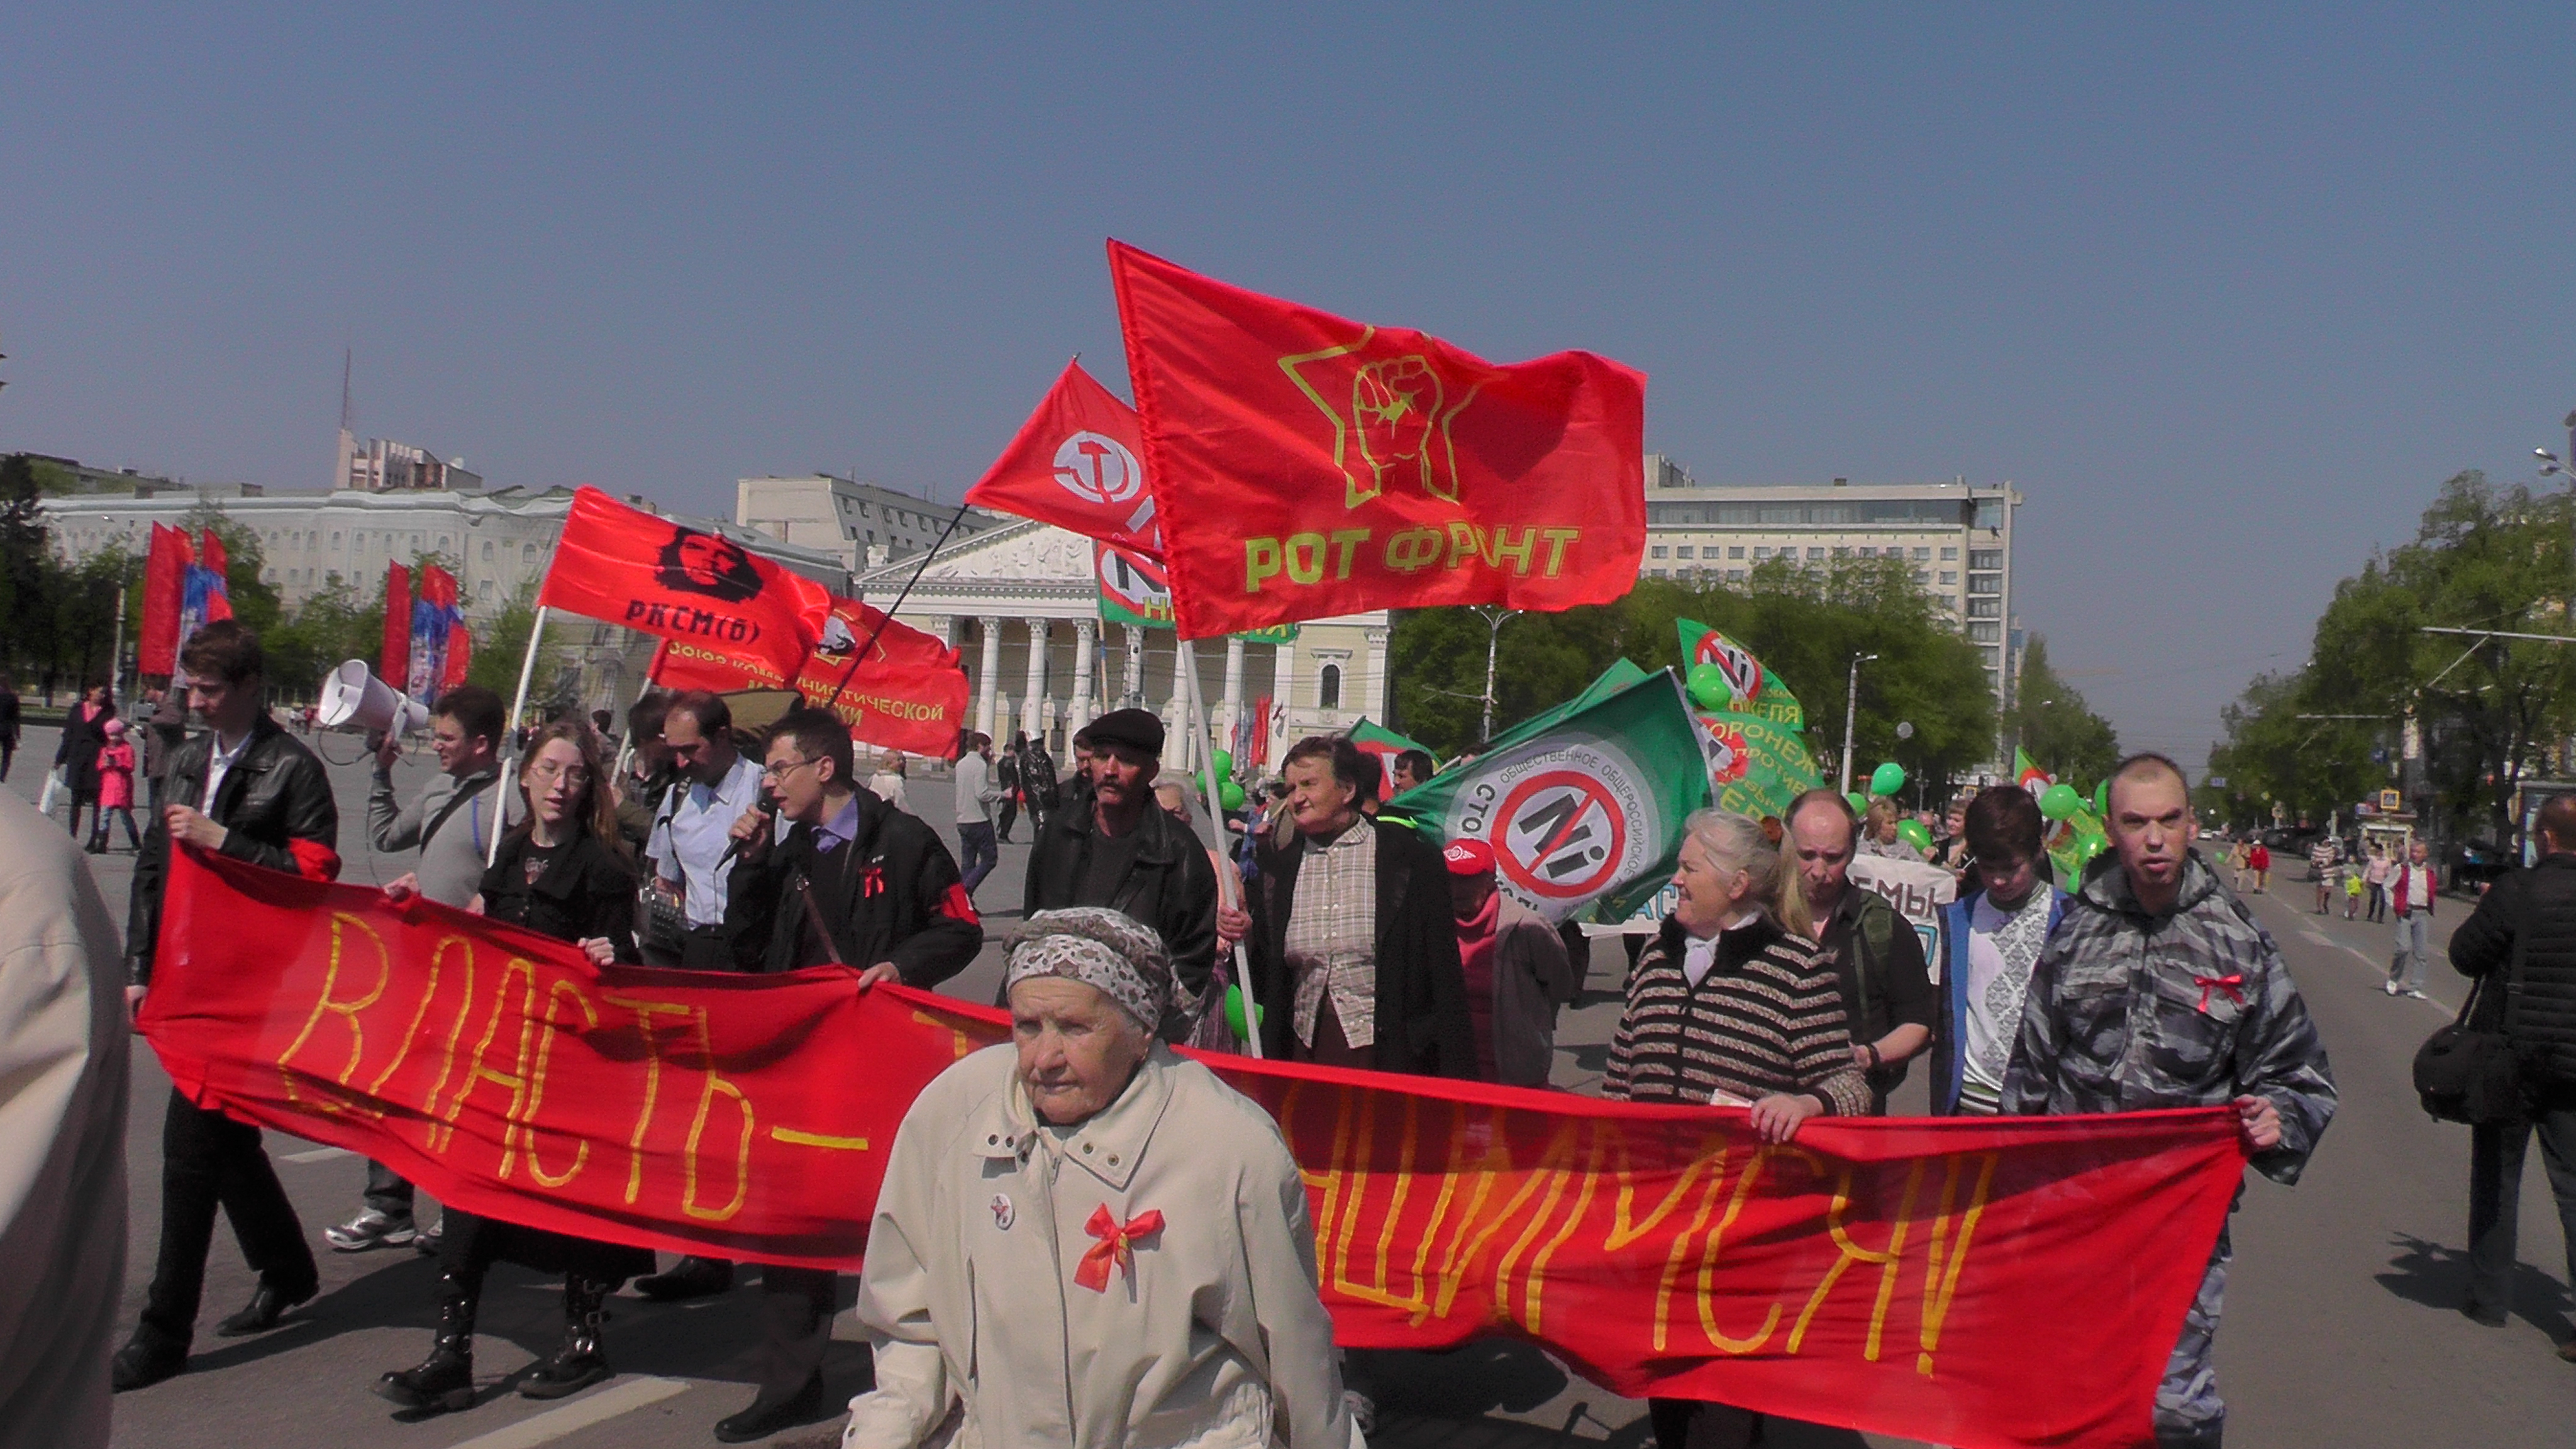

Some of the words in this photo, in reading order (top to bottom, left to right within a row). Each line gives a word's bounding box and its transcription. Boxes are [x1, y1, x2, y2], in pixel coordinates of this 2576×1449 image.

[1245, 528, 1370, 592] РОТ
[1709, 721, 1816, 777] ОРОНЕЖ
[1500, 750, 1600, 784] ОБЩЕСТВЕННОЕ
[1601, 765, 1645, 877] ОБЩЕРОССИЙСКОЕ
[275, 911, 755, 1221] ВЛАСТЬ
